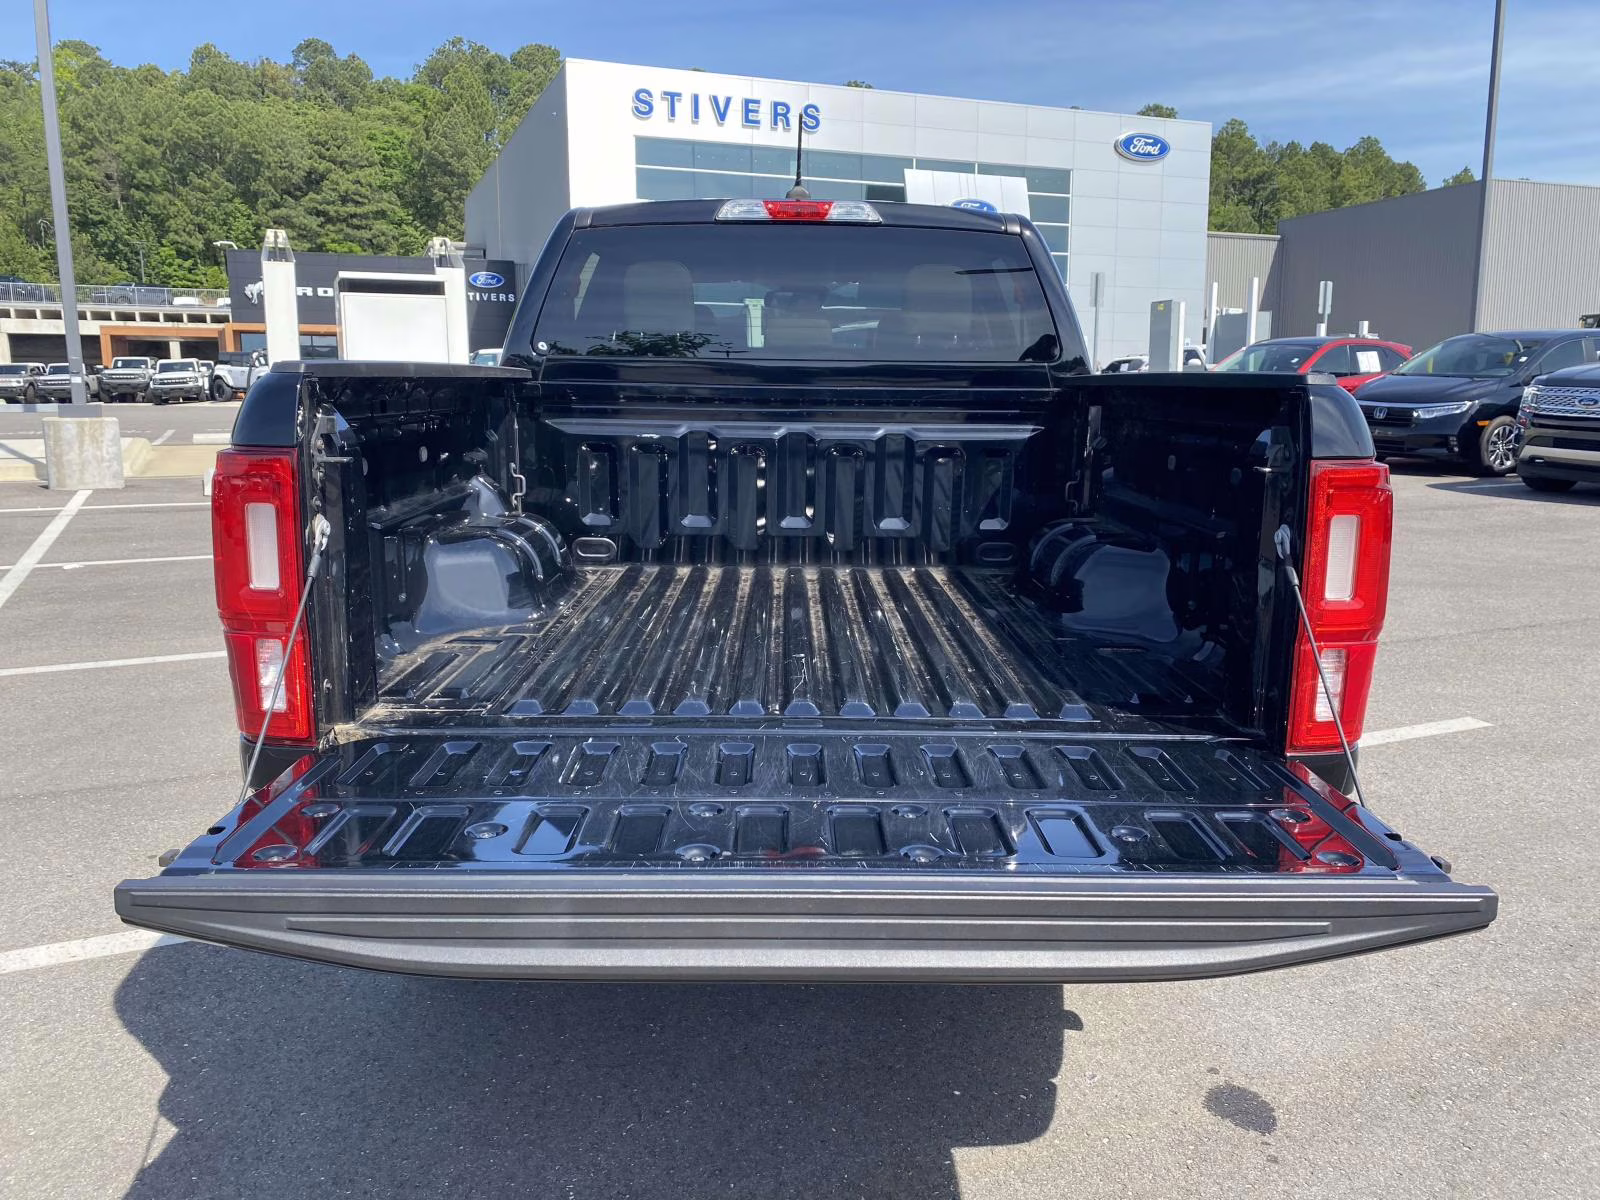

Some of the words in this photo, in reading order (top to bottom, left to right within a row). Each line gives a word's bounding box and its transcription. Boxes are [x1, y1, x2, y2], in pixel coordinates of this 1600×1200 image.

[633, 88, 821, 132] STIVERS
[1130, 137, 1161, 155] Ford
[476, 274, 498, 285] Ford
[467, 292, 515, 302] TIVERS
